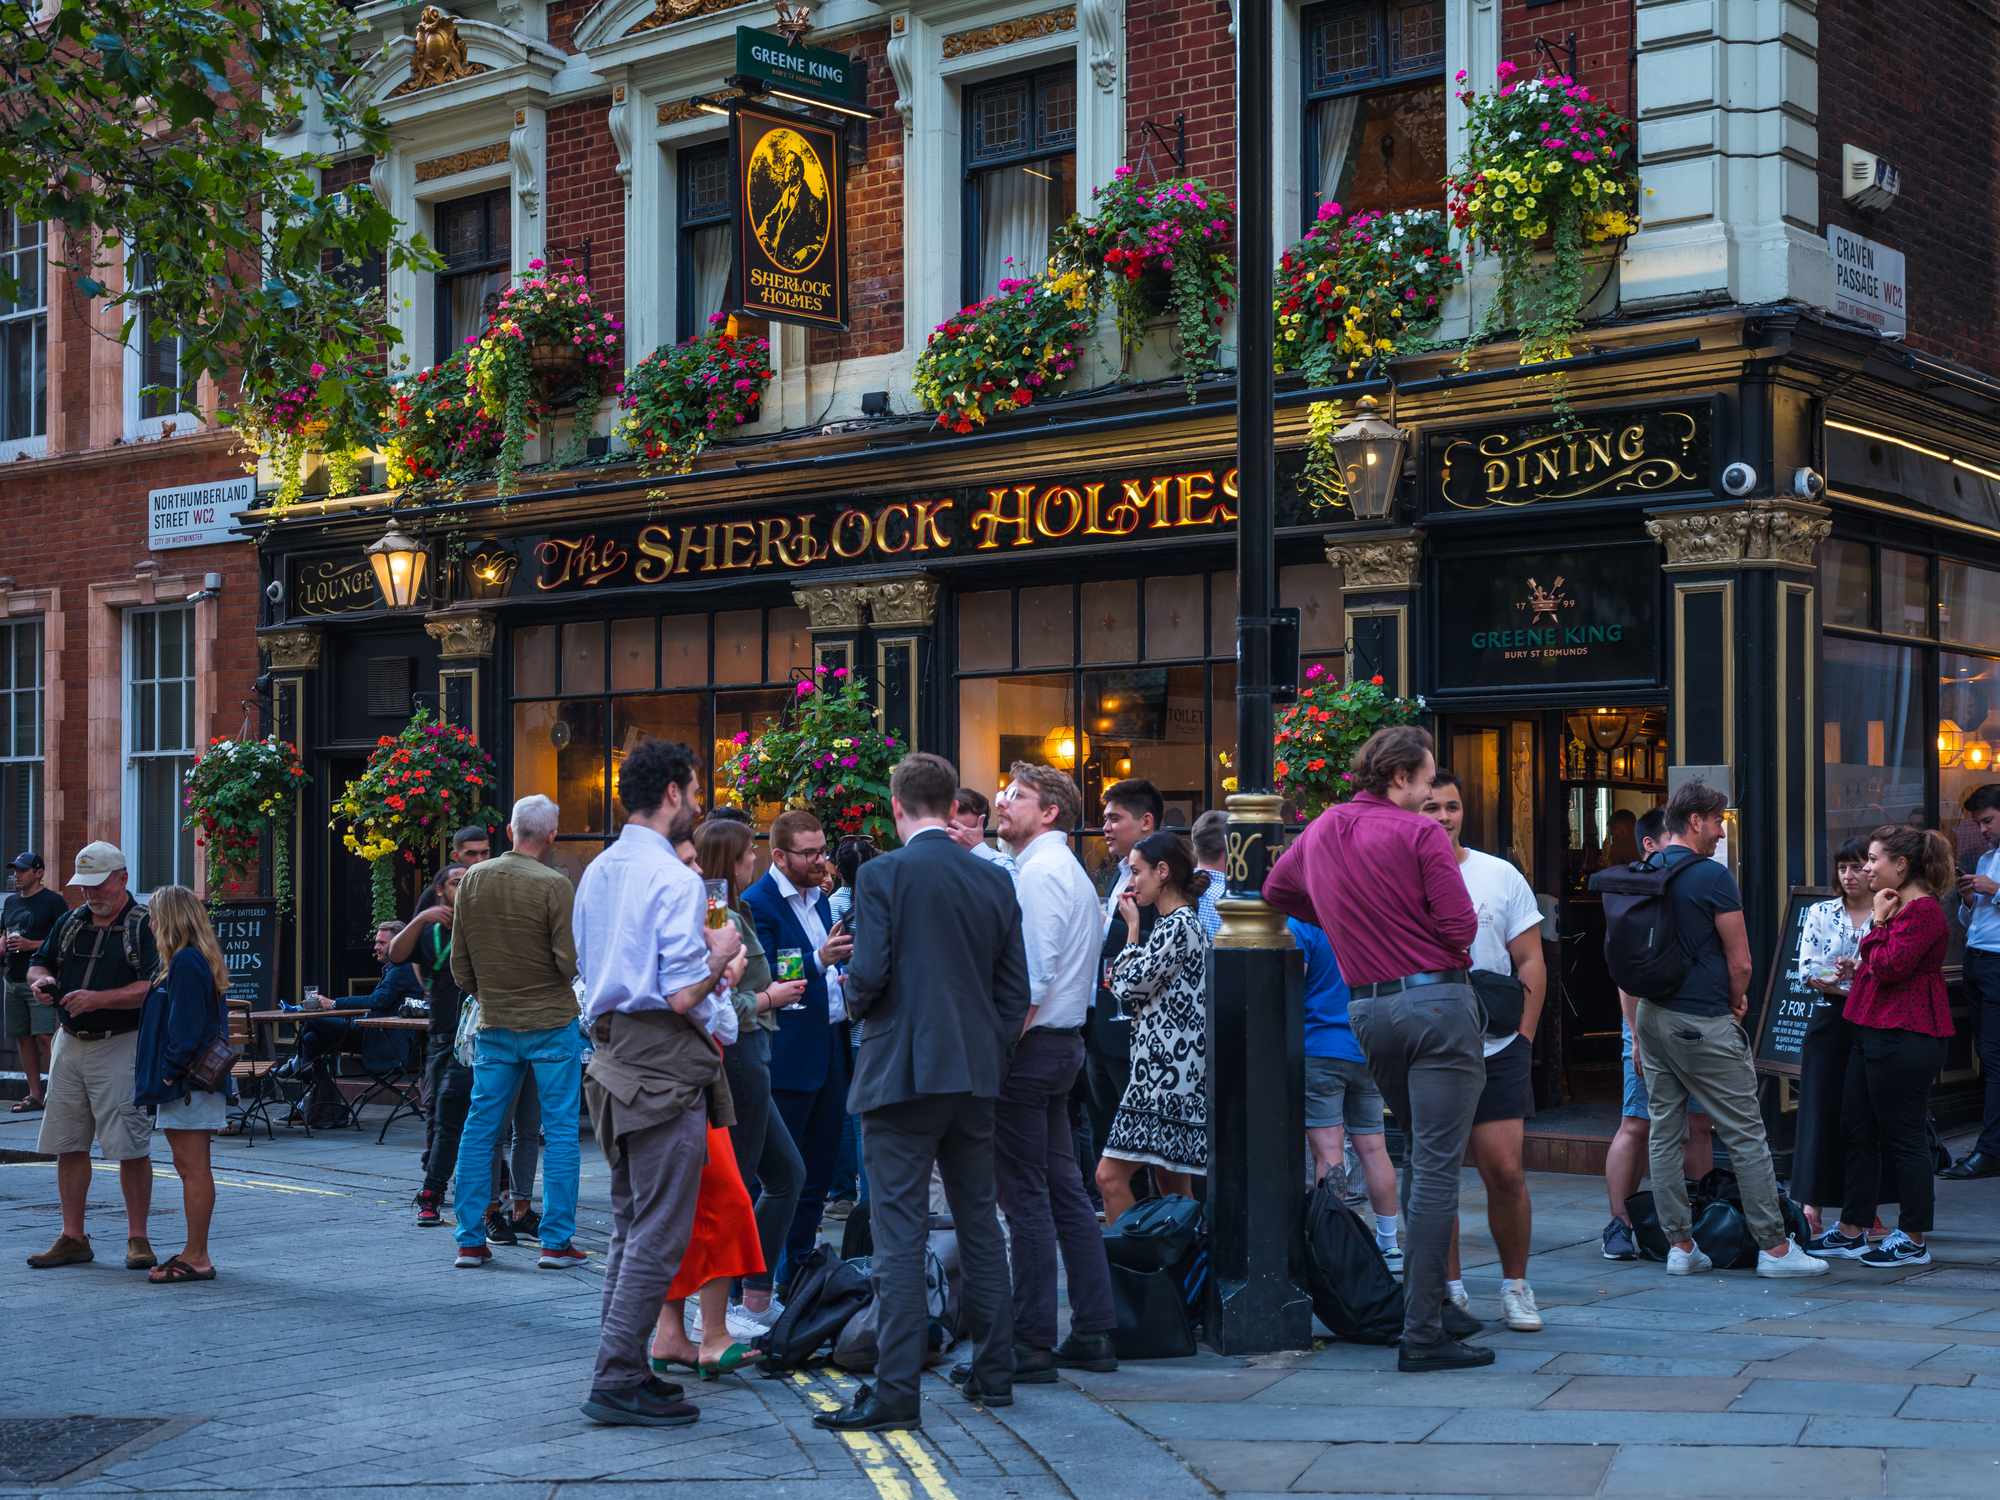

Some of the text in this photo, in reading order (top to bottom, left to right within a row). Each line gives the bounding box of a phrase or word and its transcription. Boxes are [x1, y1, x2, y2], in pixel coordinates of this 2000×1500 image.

[751, 46, 843, 83] GREENE KING
[772, 69, 787, 77] BURY
[796, 75, 822, 88] EDMUNDS
[1836, 236, 1874, 271] CRAVEN
[751, 268, 831, 297] SHERLOCK
[1837, 264, 1902, 309] PASSAGE WC2
[761, 287, 823, 311] HOLMES
[1838, 300, 1885, 326] CITY OF WESTMINSTER
[1484, 425, 1645, 492] DINING
[154, 484, 248, 511] NORTHUMBERLAND
[154, 508, 214, 529] STREET WC2
[154, 533, 203, 546] CITY OF WESTMINSTER
[533, 533, 628, 590] The
[634, 497, 954, 584] SHERLOCK
[306, 569, 374, 604] LOUNGE
[1516, 600, 1576, 610] 17 99
[1471, 624, 1623, 649] GREENE KING
[1504, 650, 1528, 659] BURY
[1544, 647, 1588, 657] EDMUNDS
[215, 908, 266, 917] CRISPY BATTERED
[217, 921, 260, 937] FISH
[226, 940, 249, 950] AND
[224, 953, 262, 969] HIPS
[1778, 999, 1814, 1018] 2 FOR 1
